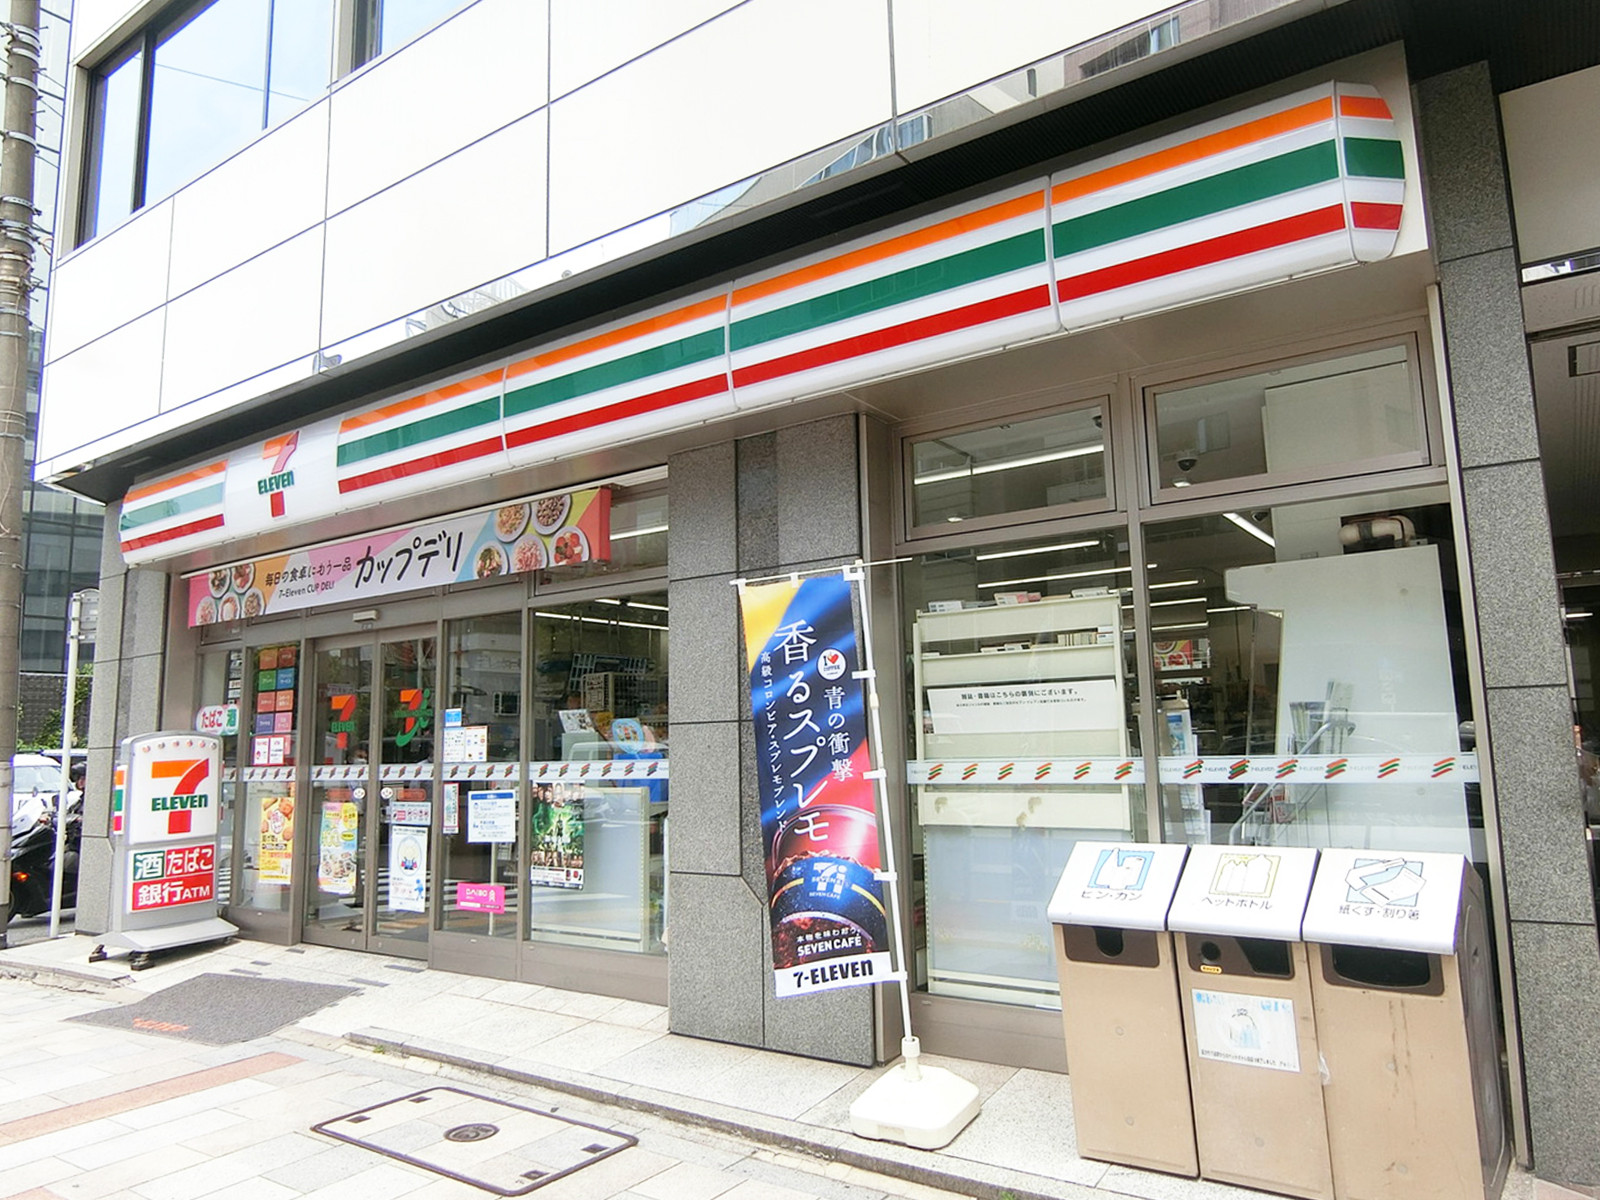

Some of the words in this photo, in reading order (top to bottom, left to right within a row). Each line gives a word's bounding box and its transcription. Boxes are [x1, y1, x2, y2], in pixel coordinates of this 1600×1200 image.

[262, 430, 299, 517] 7
[265, 557, 352, 587] 毎日の食卓にもう一品
[354, 529, 463, 588] カップデリ
[278, 586, 306, 598] 7-Eleven
[306, 582, 321, 594] CUP
[321, 580, 335, 592] DELI
[201, 709, 223, 729] たばこ
[774, 619, 829, 841] 香るスプレモ
[823, 686, 853, 780] 青の衝撃
[152, 758, 209, 834] 7
[135, 853, 164, 880] 酒
[167, 848, 213, 875] たばこ
[138, 881, 210, 906] 銀行ATM
[797, 940, 833, 957] SEVEN
